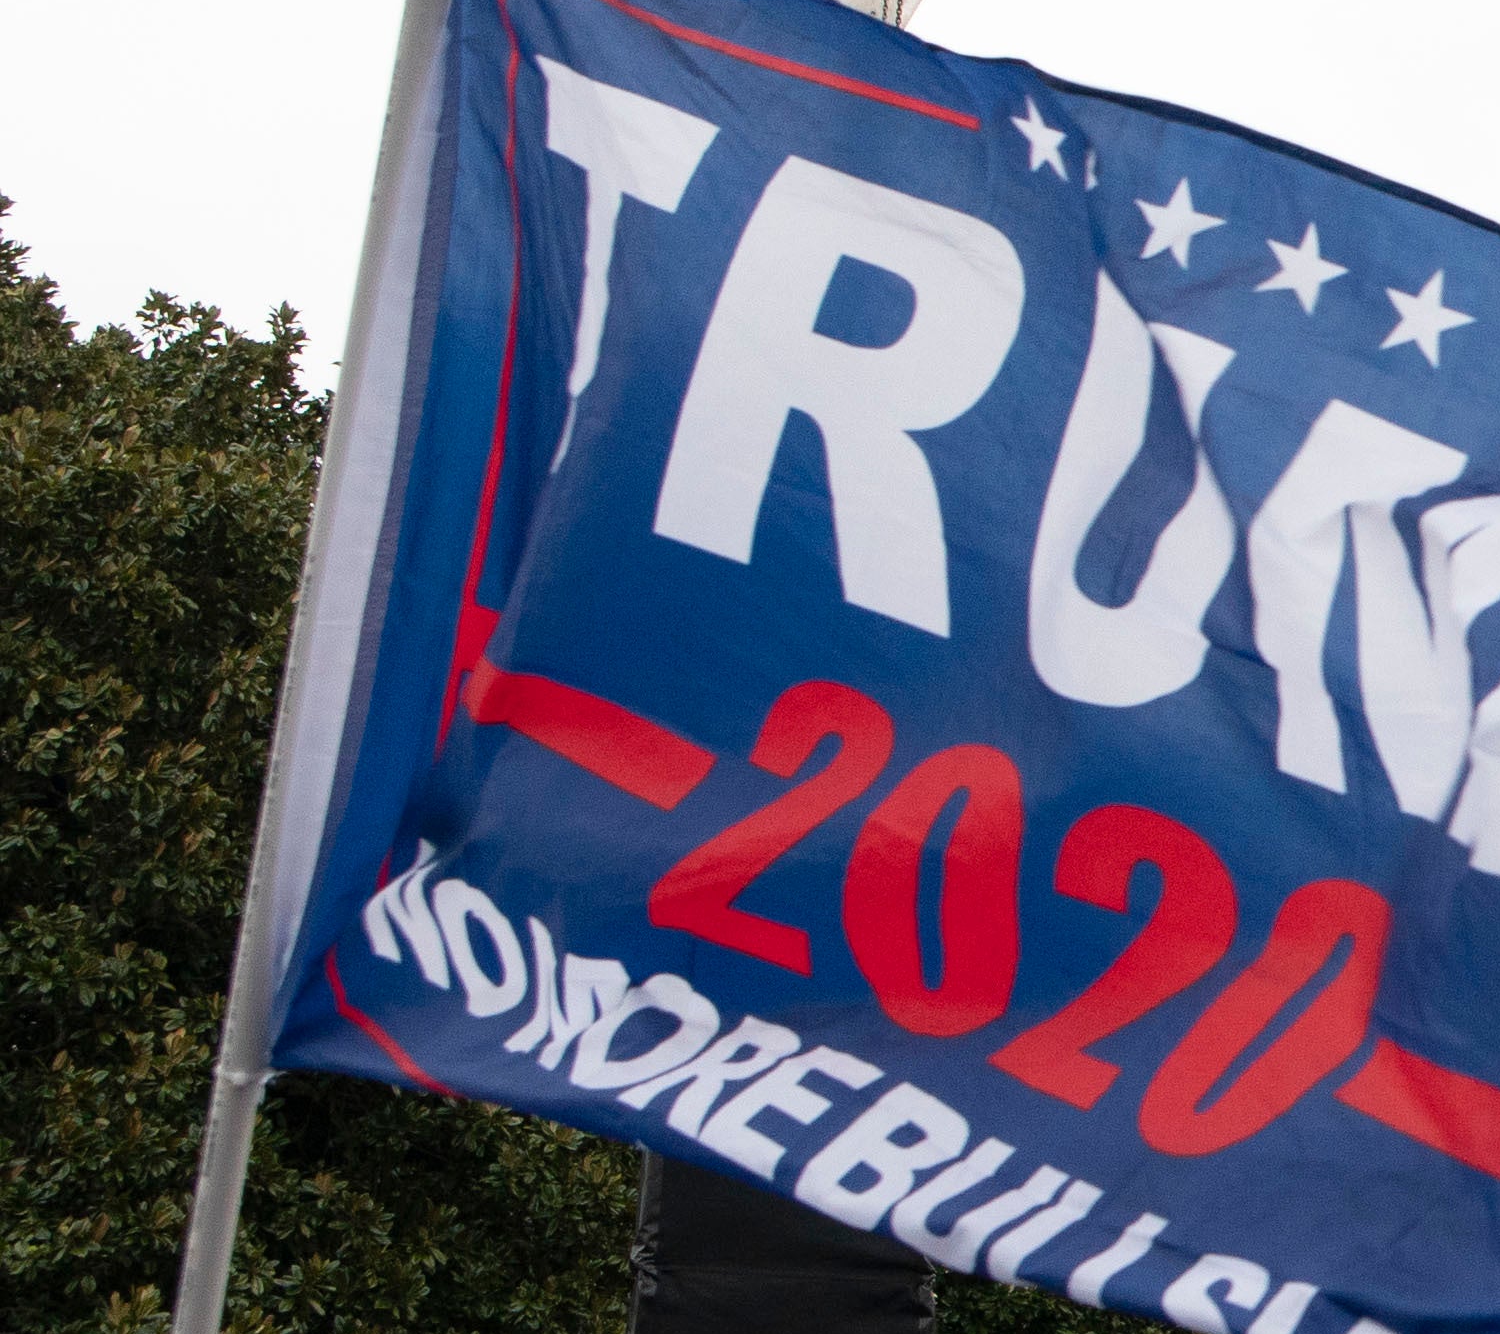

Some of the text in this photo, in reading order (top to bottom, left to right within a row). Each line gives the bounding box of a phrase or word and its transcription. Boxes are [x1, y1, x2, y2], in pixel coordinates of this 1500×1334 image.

[361, 838, 528, 1018] NO
[503, 916, 885, 1181] MORE
[646, 680, 1393, 1157] 2020
